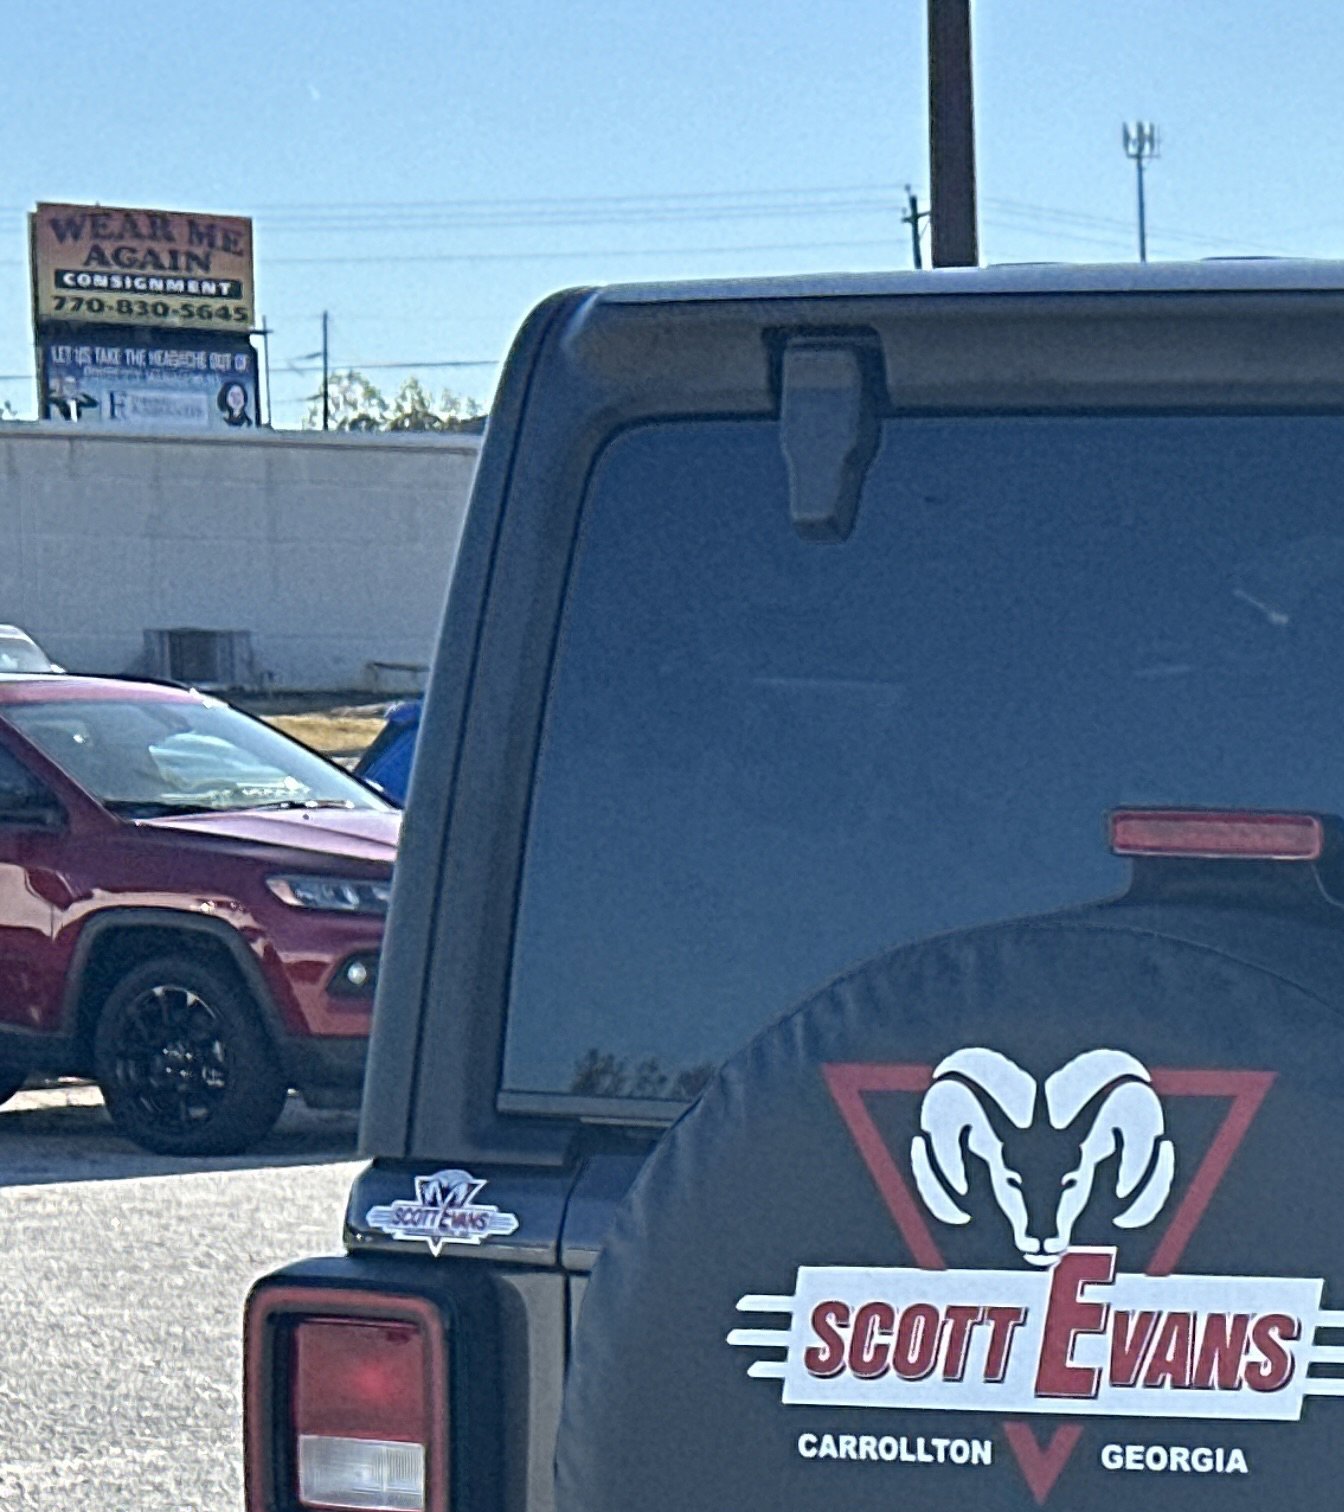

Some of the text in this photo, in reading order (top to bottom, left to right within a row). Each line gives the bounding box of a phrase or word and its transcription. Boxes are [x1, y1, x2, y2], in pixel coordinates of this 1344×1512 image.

[50, 213, 244, 256] WEAR ME
[83, 244, 213, 273] AGAIN
[62, 272, 232, 295] CONSIGNMENT
[52, 296, 249, 322] 770-830-5645
[51, 346, 70, 364] LET
[75, 346, 90, 366] US
[94, 347, 120, 365] TAKE
[125, 349, 146, 367] THE
[804, 1246, 1301, 1399] SCOTT EVANS
[798, 1433, 1249, 1475] CARROLLTON GEORGIA
